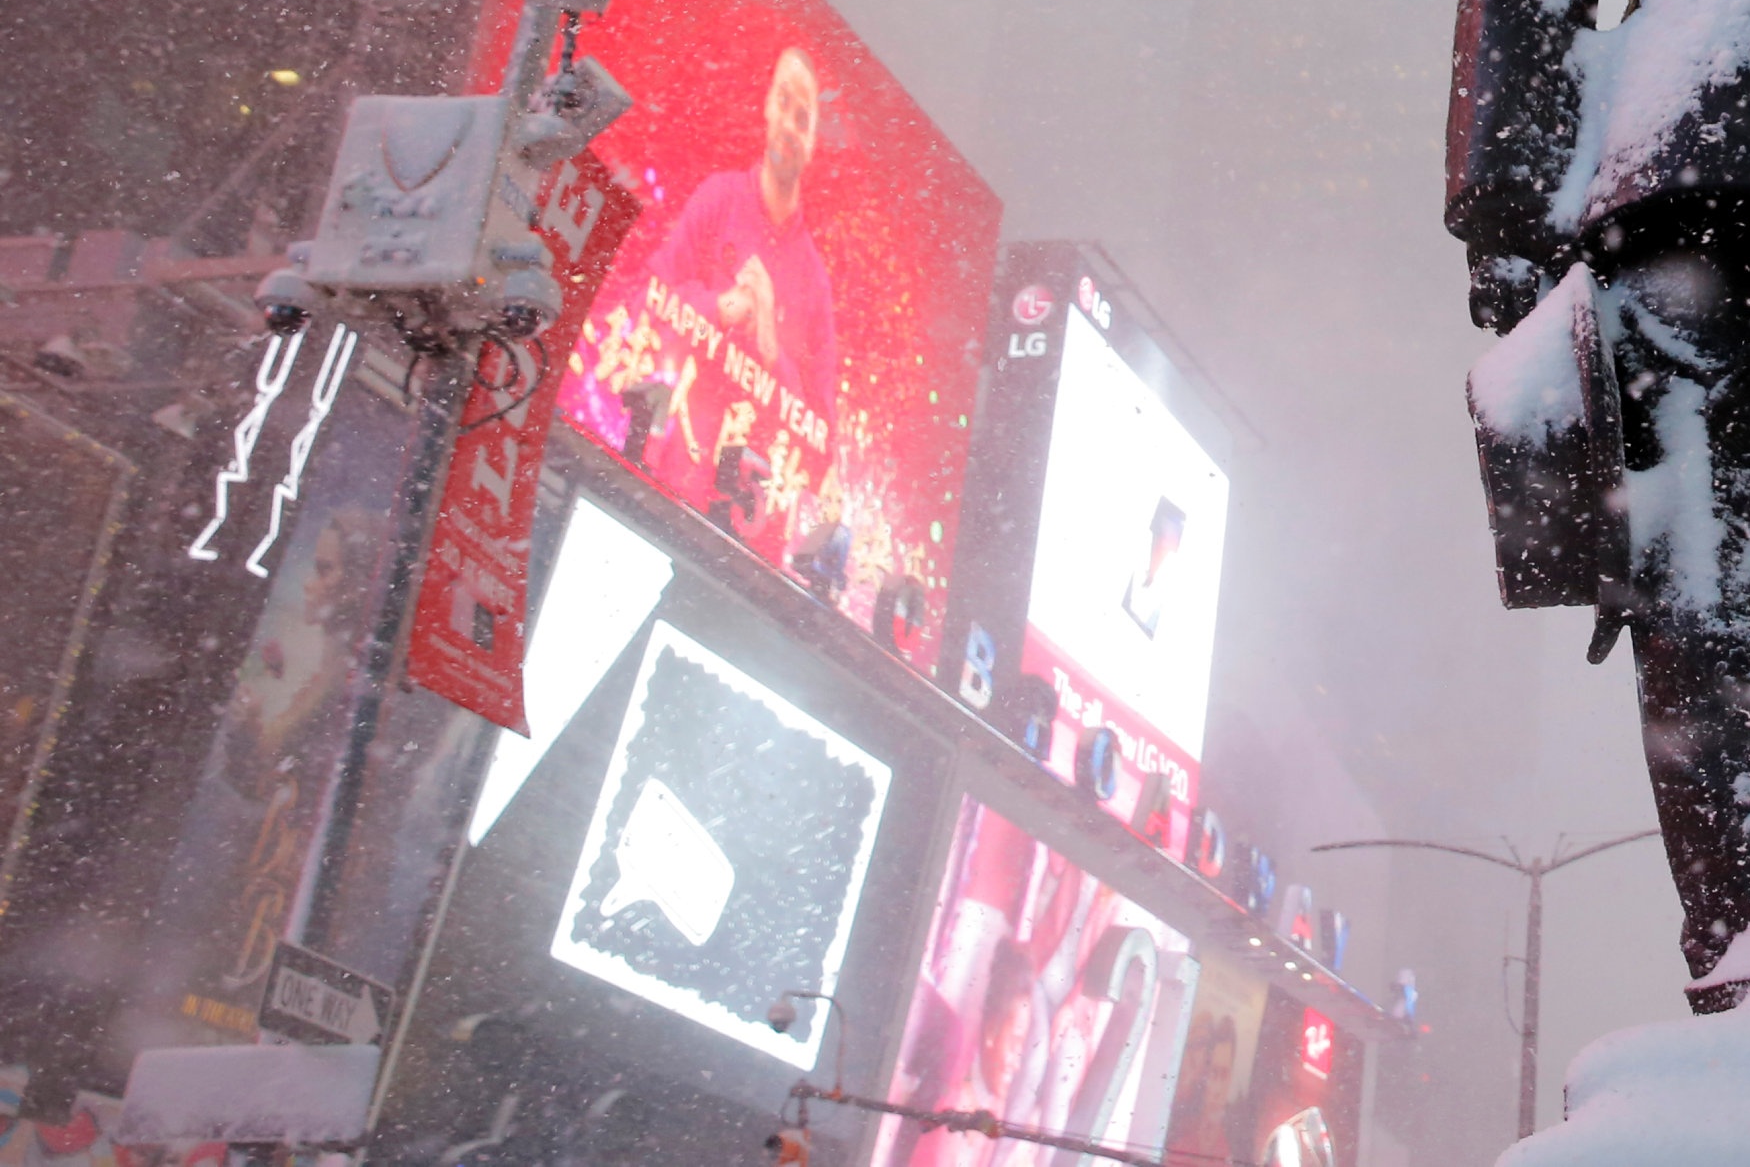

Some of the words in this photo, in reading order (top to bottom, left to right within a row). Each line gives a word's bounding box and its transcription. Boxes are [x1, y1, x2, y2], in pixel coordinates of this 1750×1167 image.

[648, 276, 723, 359] HAPPY
[723, 342, 776, 406] NEW
[777, 386, 829, 455] YEAR
[1008, 332, 1048, 358] LG
[272, 968, 319, 1017] ONE
[320, 988, 358, 1035] WAY
